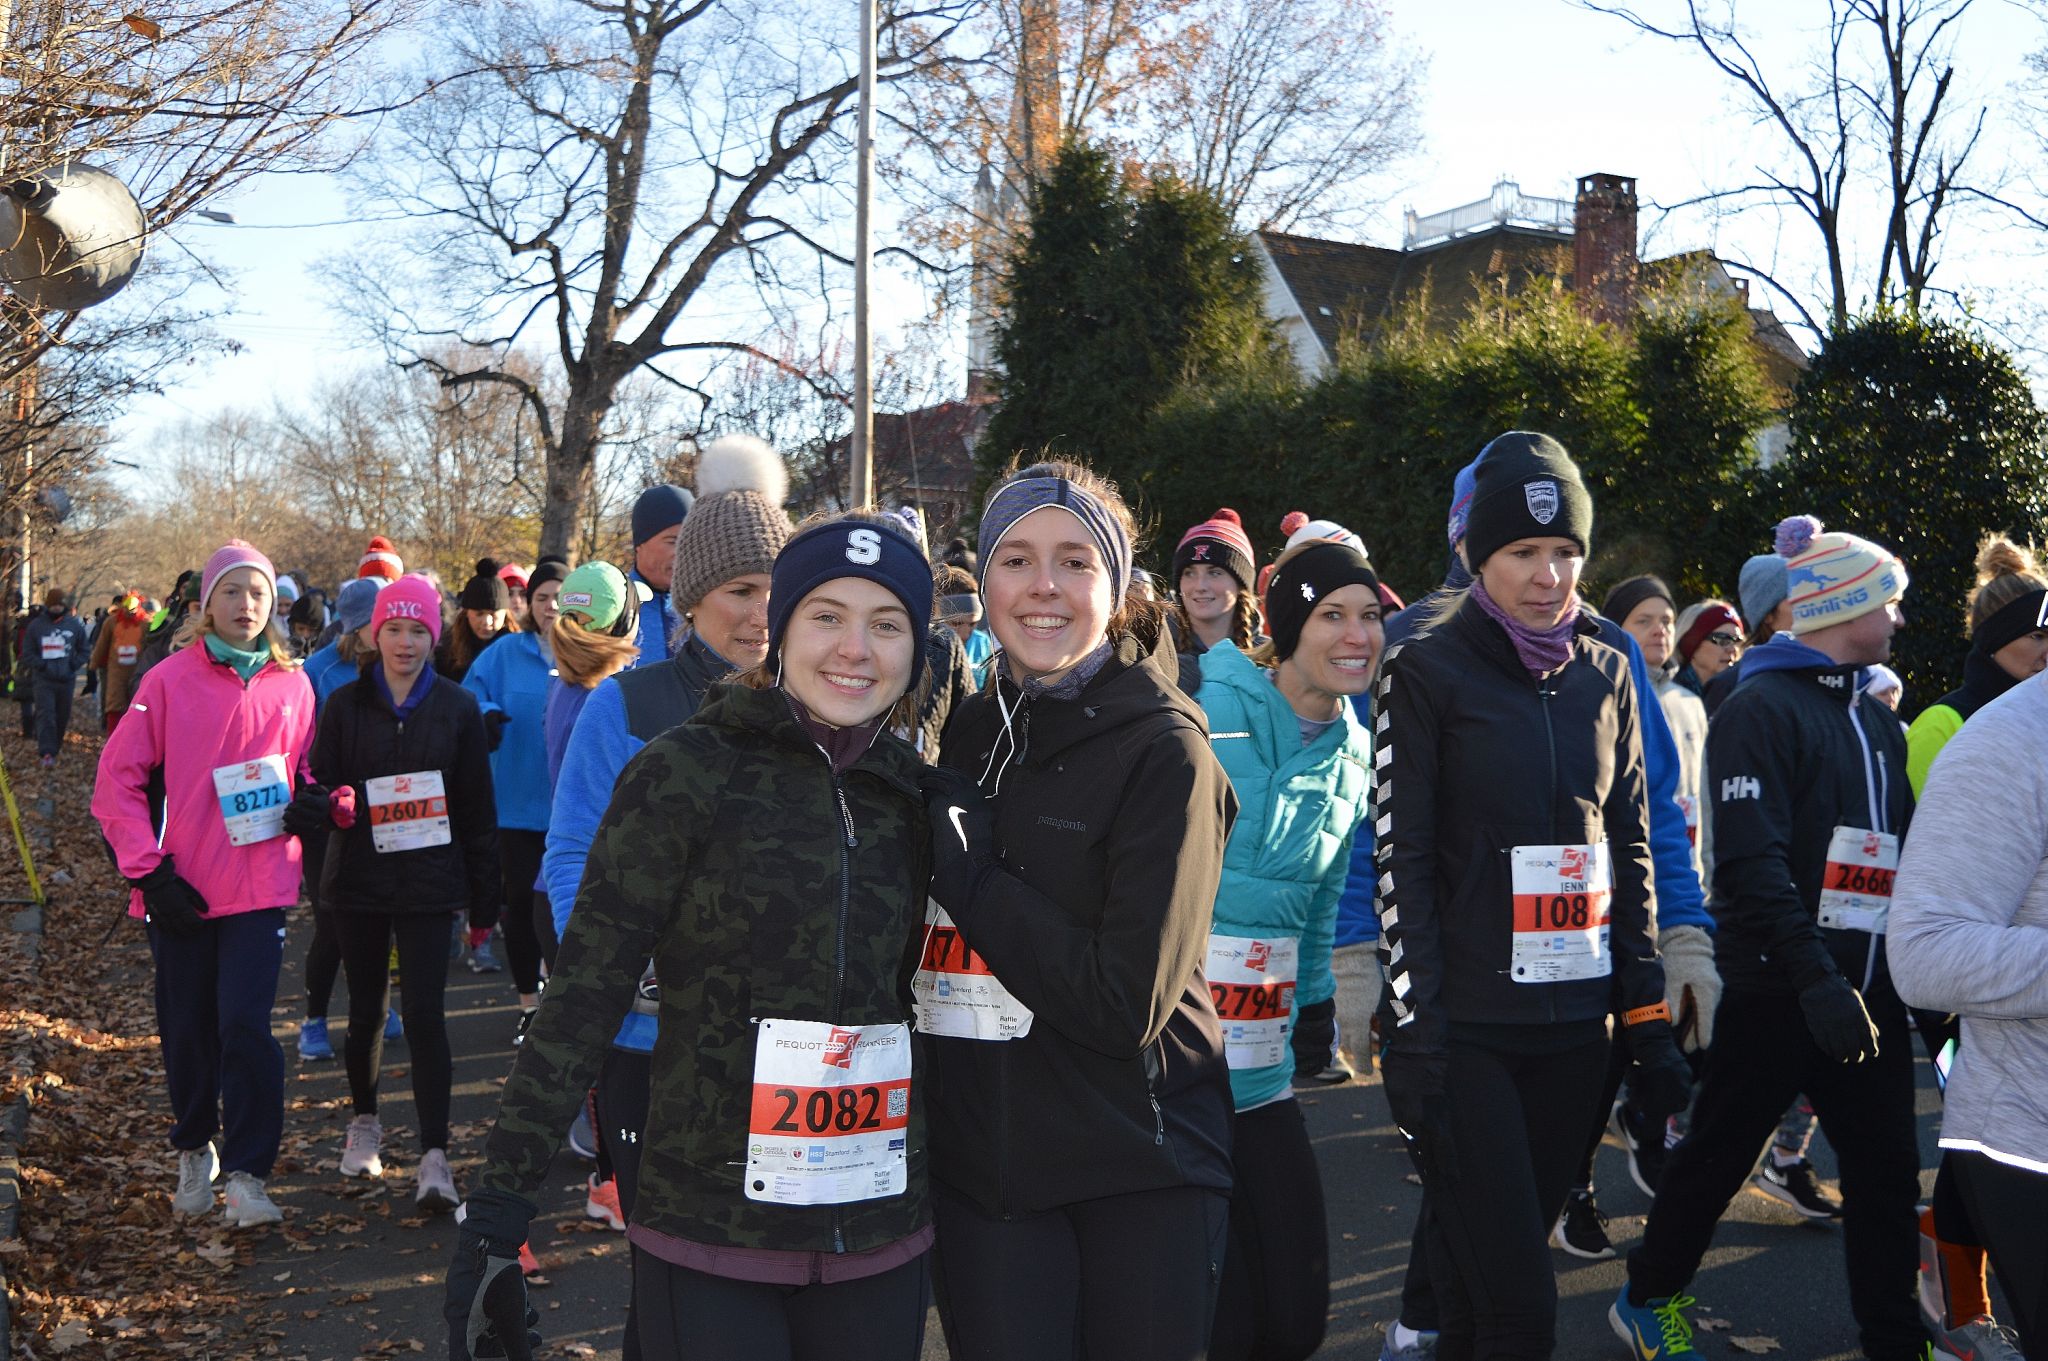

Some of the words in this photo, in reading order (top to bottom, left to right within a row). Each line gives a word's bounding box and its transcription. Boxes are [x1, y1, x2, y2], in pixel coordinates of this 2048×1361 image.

[845, 528, 881, 566] S
[386, 600, 422, 618] NYC
[1721, 775, 1761, 802] HH
[379, 799, 429, 823] 2607
[1535, 895, 1587, 928] 108
[1211, 984, 1280, 1018] 2794
[776, 1039, 823, 1051] PEQUOT
[771, 1086, 881, 1134] 2082
